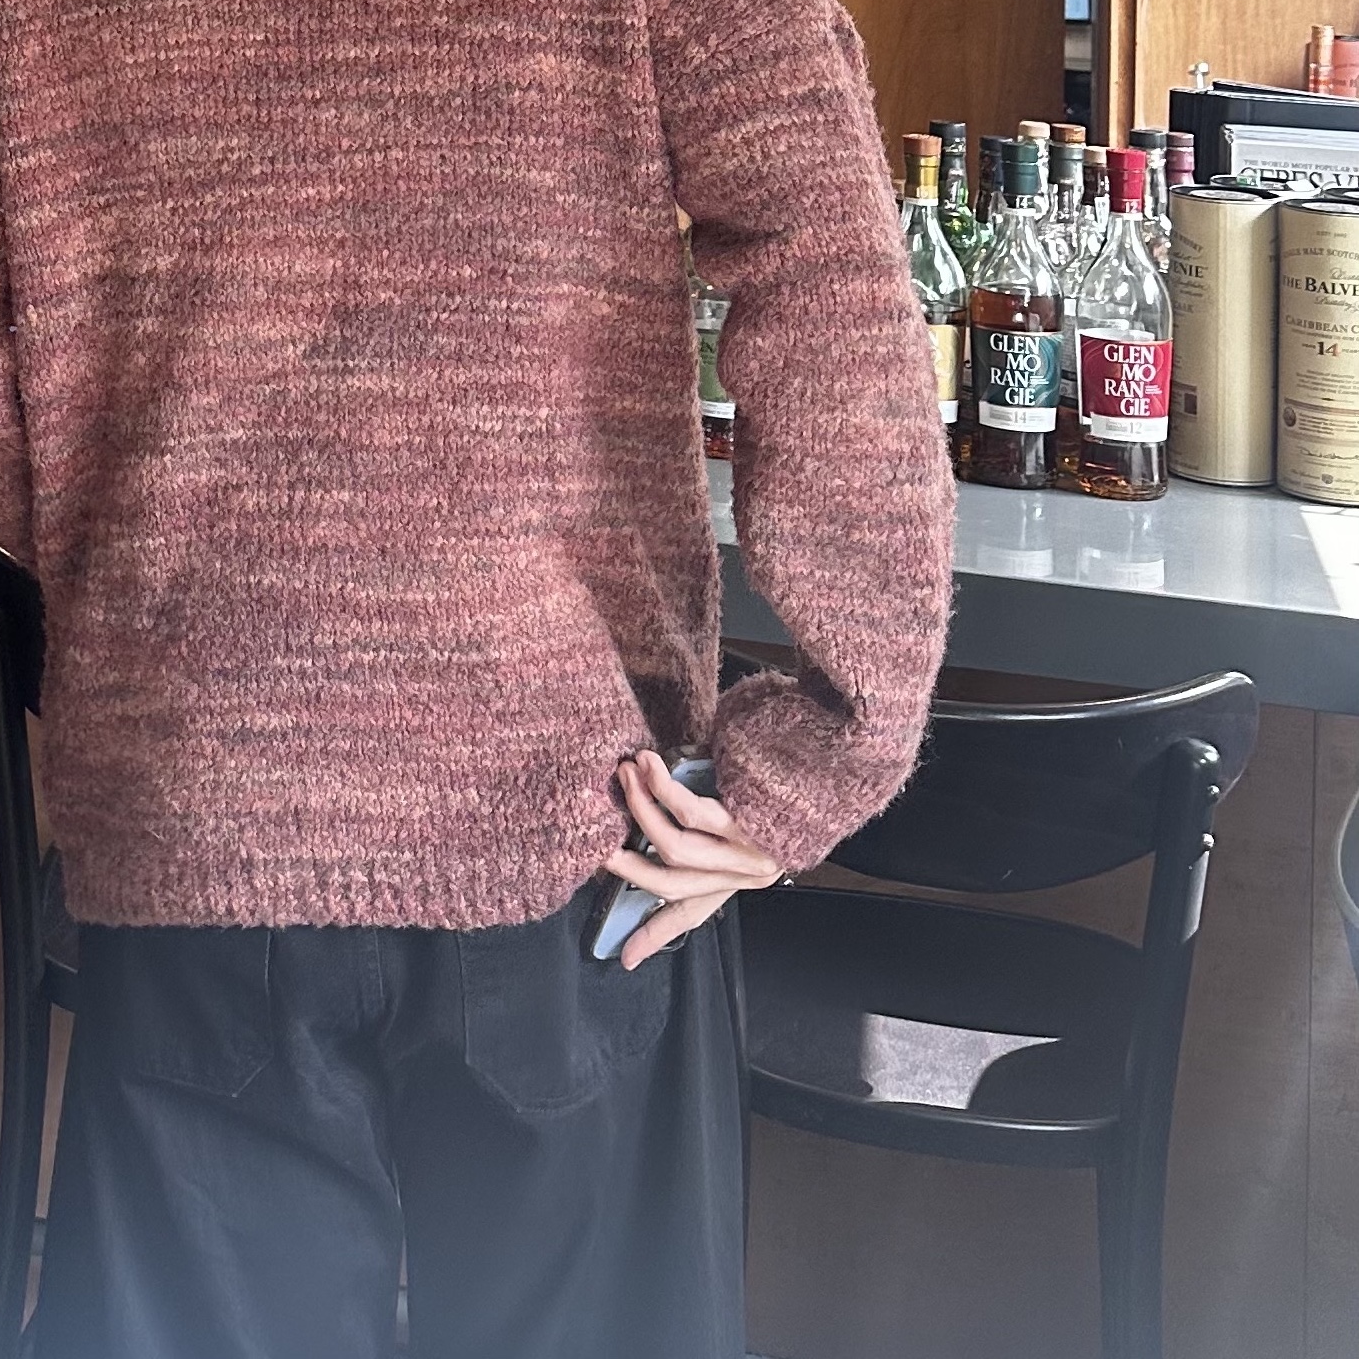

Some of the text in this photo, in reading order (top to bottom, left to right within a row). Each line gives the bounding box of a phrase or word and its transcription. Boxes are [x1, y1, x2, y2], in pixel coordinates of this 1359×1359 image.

[1262, 160, 1289, 168] WORLD
[1015, 196, 1028, 209] 14
[1125, 201, 1139, 214] 12
[1283, 275, 1302, 290] THE
[1285, 314, 1349, 333] CARIBBEAN
[990, 333, 1041, 354] GLEN
[1317, 341, 1339, 357] 14
[1005, 352, 1041, 372] MO
[1103, 344, 1155, 364] GLEN
[990, 368, 1030, 388] RAN
[1121, 363, 1156, 383] MO
[1005, 387, 1036, 406] GIE
[1104, 379, 1144, 399] RAN
[1120, 397, 1151, 416] GIE
[1013, 410, 1028, 424] 14
[1129, 421, 1143, 435] 12
